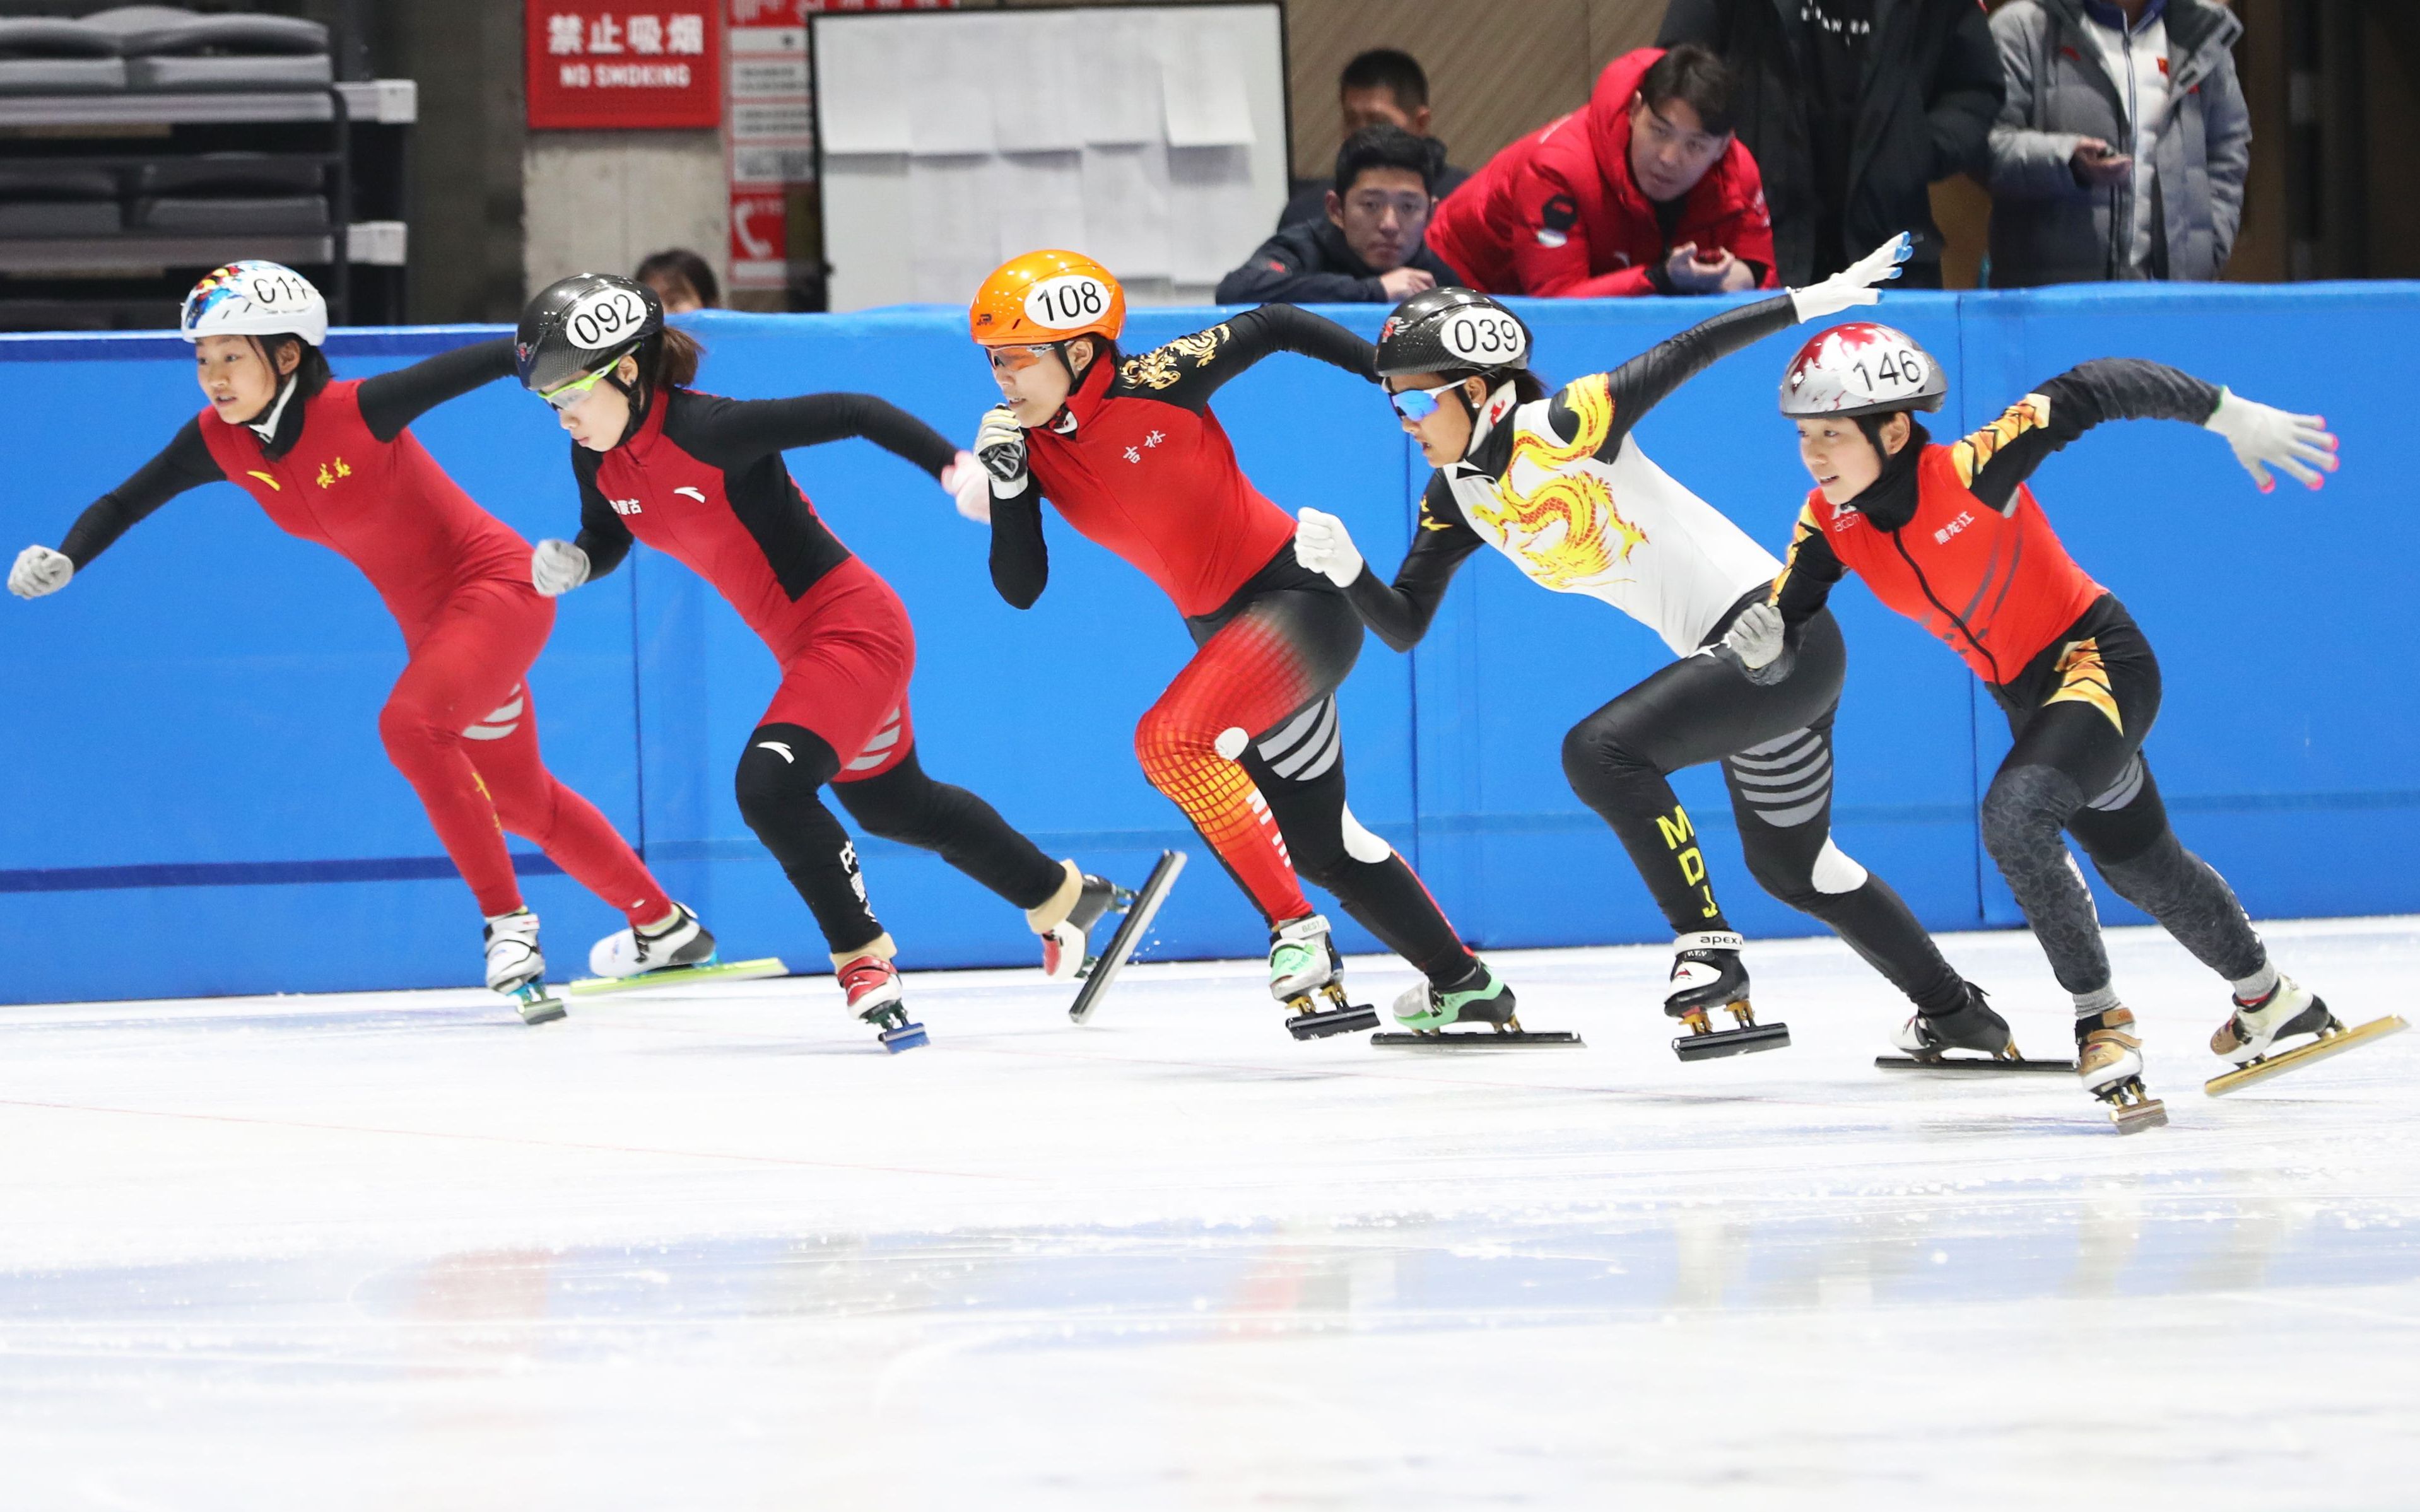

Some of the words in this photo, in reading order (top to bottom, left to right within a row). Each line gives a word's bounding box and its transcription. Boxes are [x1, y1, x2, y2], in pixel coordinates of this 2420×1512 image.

[548, 13, 703, 55] 禁止吸烟
[560, 64, 592, 88] NO
[594, 63, 691, 88] SMOKING
[254, 276, 308, 303] 011
[1037, 281, 1101, 322] 108
[574, 294, 642, 344] 092
[1454, 319, 1518, 353] 039
[1853, 349, 1921, 392] 146
[1123, 430, 1166, 464] 吉林
[1934, 511, 1975, 545] 黑龙江
